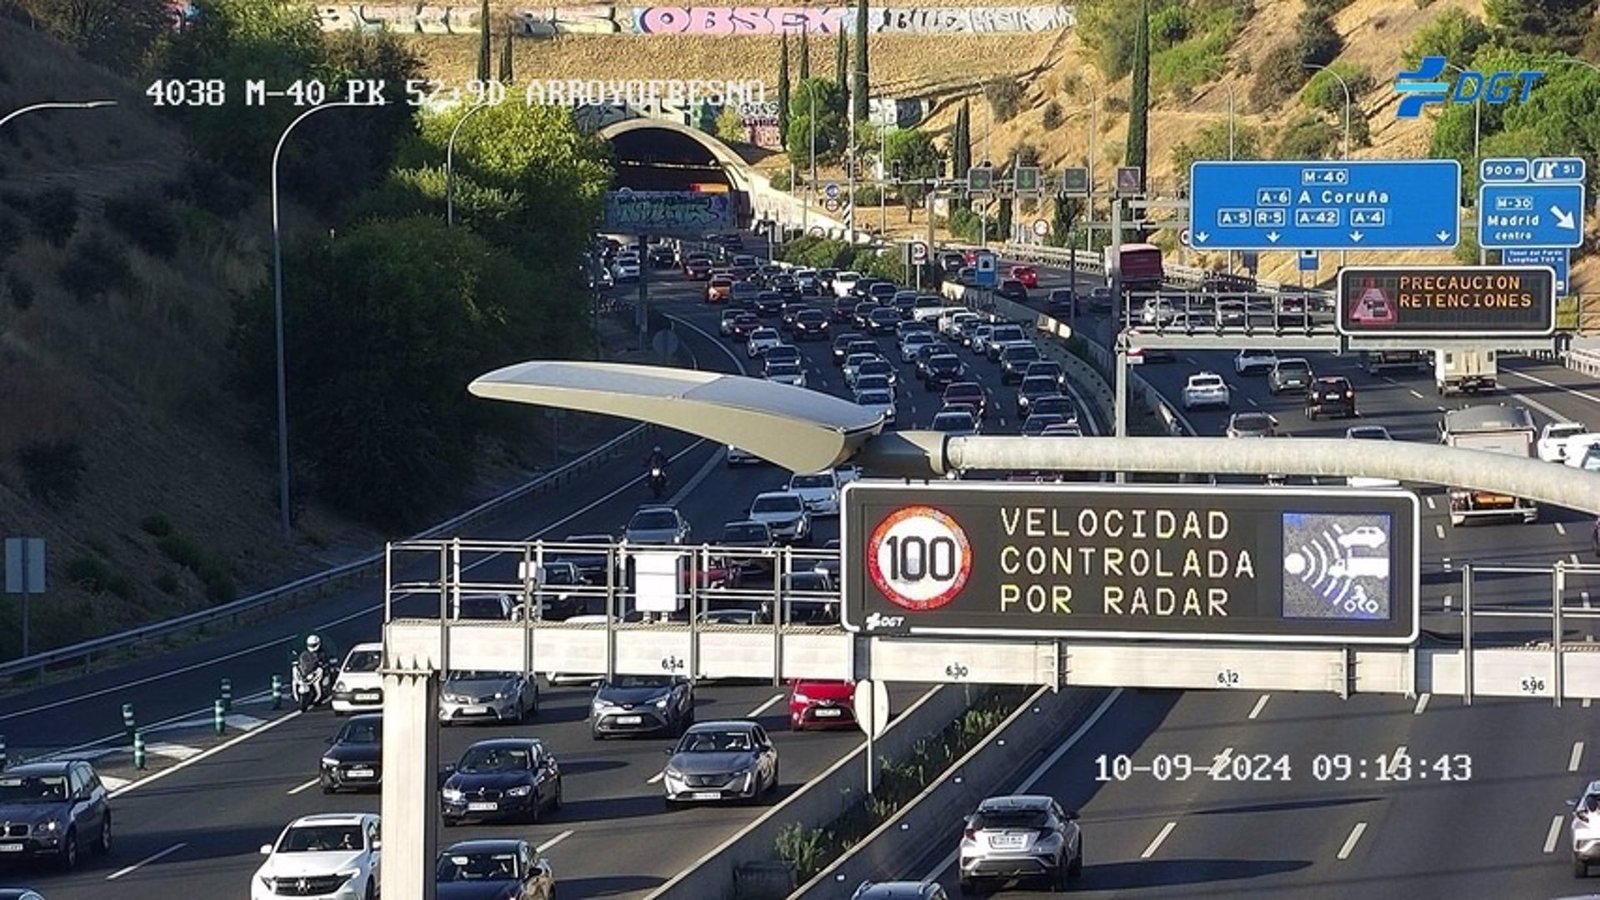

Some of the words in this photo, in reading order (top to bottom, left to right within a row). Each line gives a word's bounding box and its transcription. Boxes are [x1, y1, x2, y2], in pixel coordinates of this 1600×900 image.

[1304, 171, 1346, 183] M-40
[1485, 165, 1512, 176] 900
[1514, 167, 1526, 176] m
[1261, 190, 1288, 203] A-6
[1298, 190, 1312, 204] A
[1321, 190, 1389, 204] Coruña
[1221, 211, 1249, 224] A-5
[1257, 211, 1282, 224] R-5
[1299, 211, 1337, 224] A-42
[1354, 211, 1382, 224] A-4
[1486, 214, 1540, 227] Madrid
[1494, 231, 1533, 241] centro
[1400, 276, 1520, 291] PRECAUCION
[1400, 293, 1532, 308] RETENCIONES
[1001, 507, 1230, 539] VELOCIDAD
[886, 535, 956, 582] 100
[1001, 546, 1255, 580] CONTROLADA
[1001, 584, 1074, 614] POR
[1103, 586, 1230, 617] RADAR
[880, 616, 905, 627] DGT
